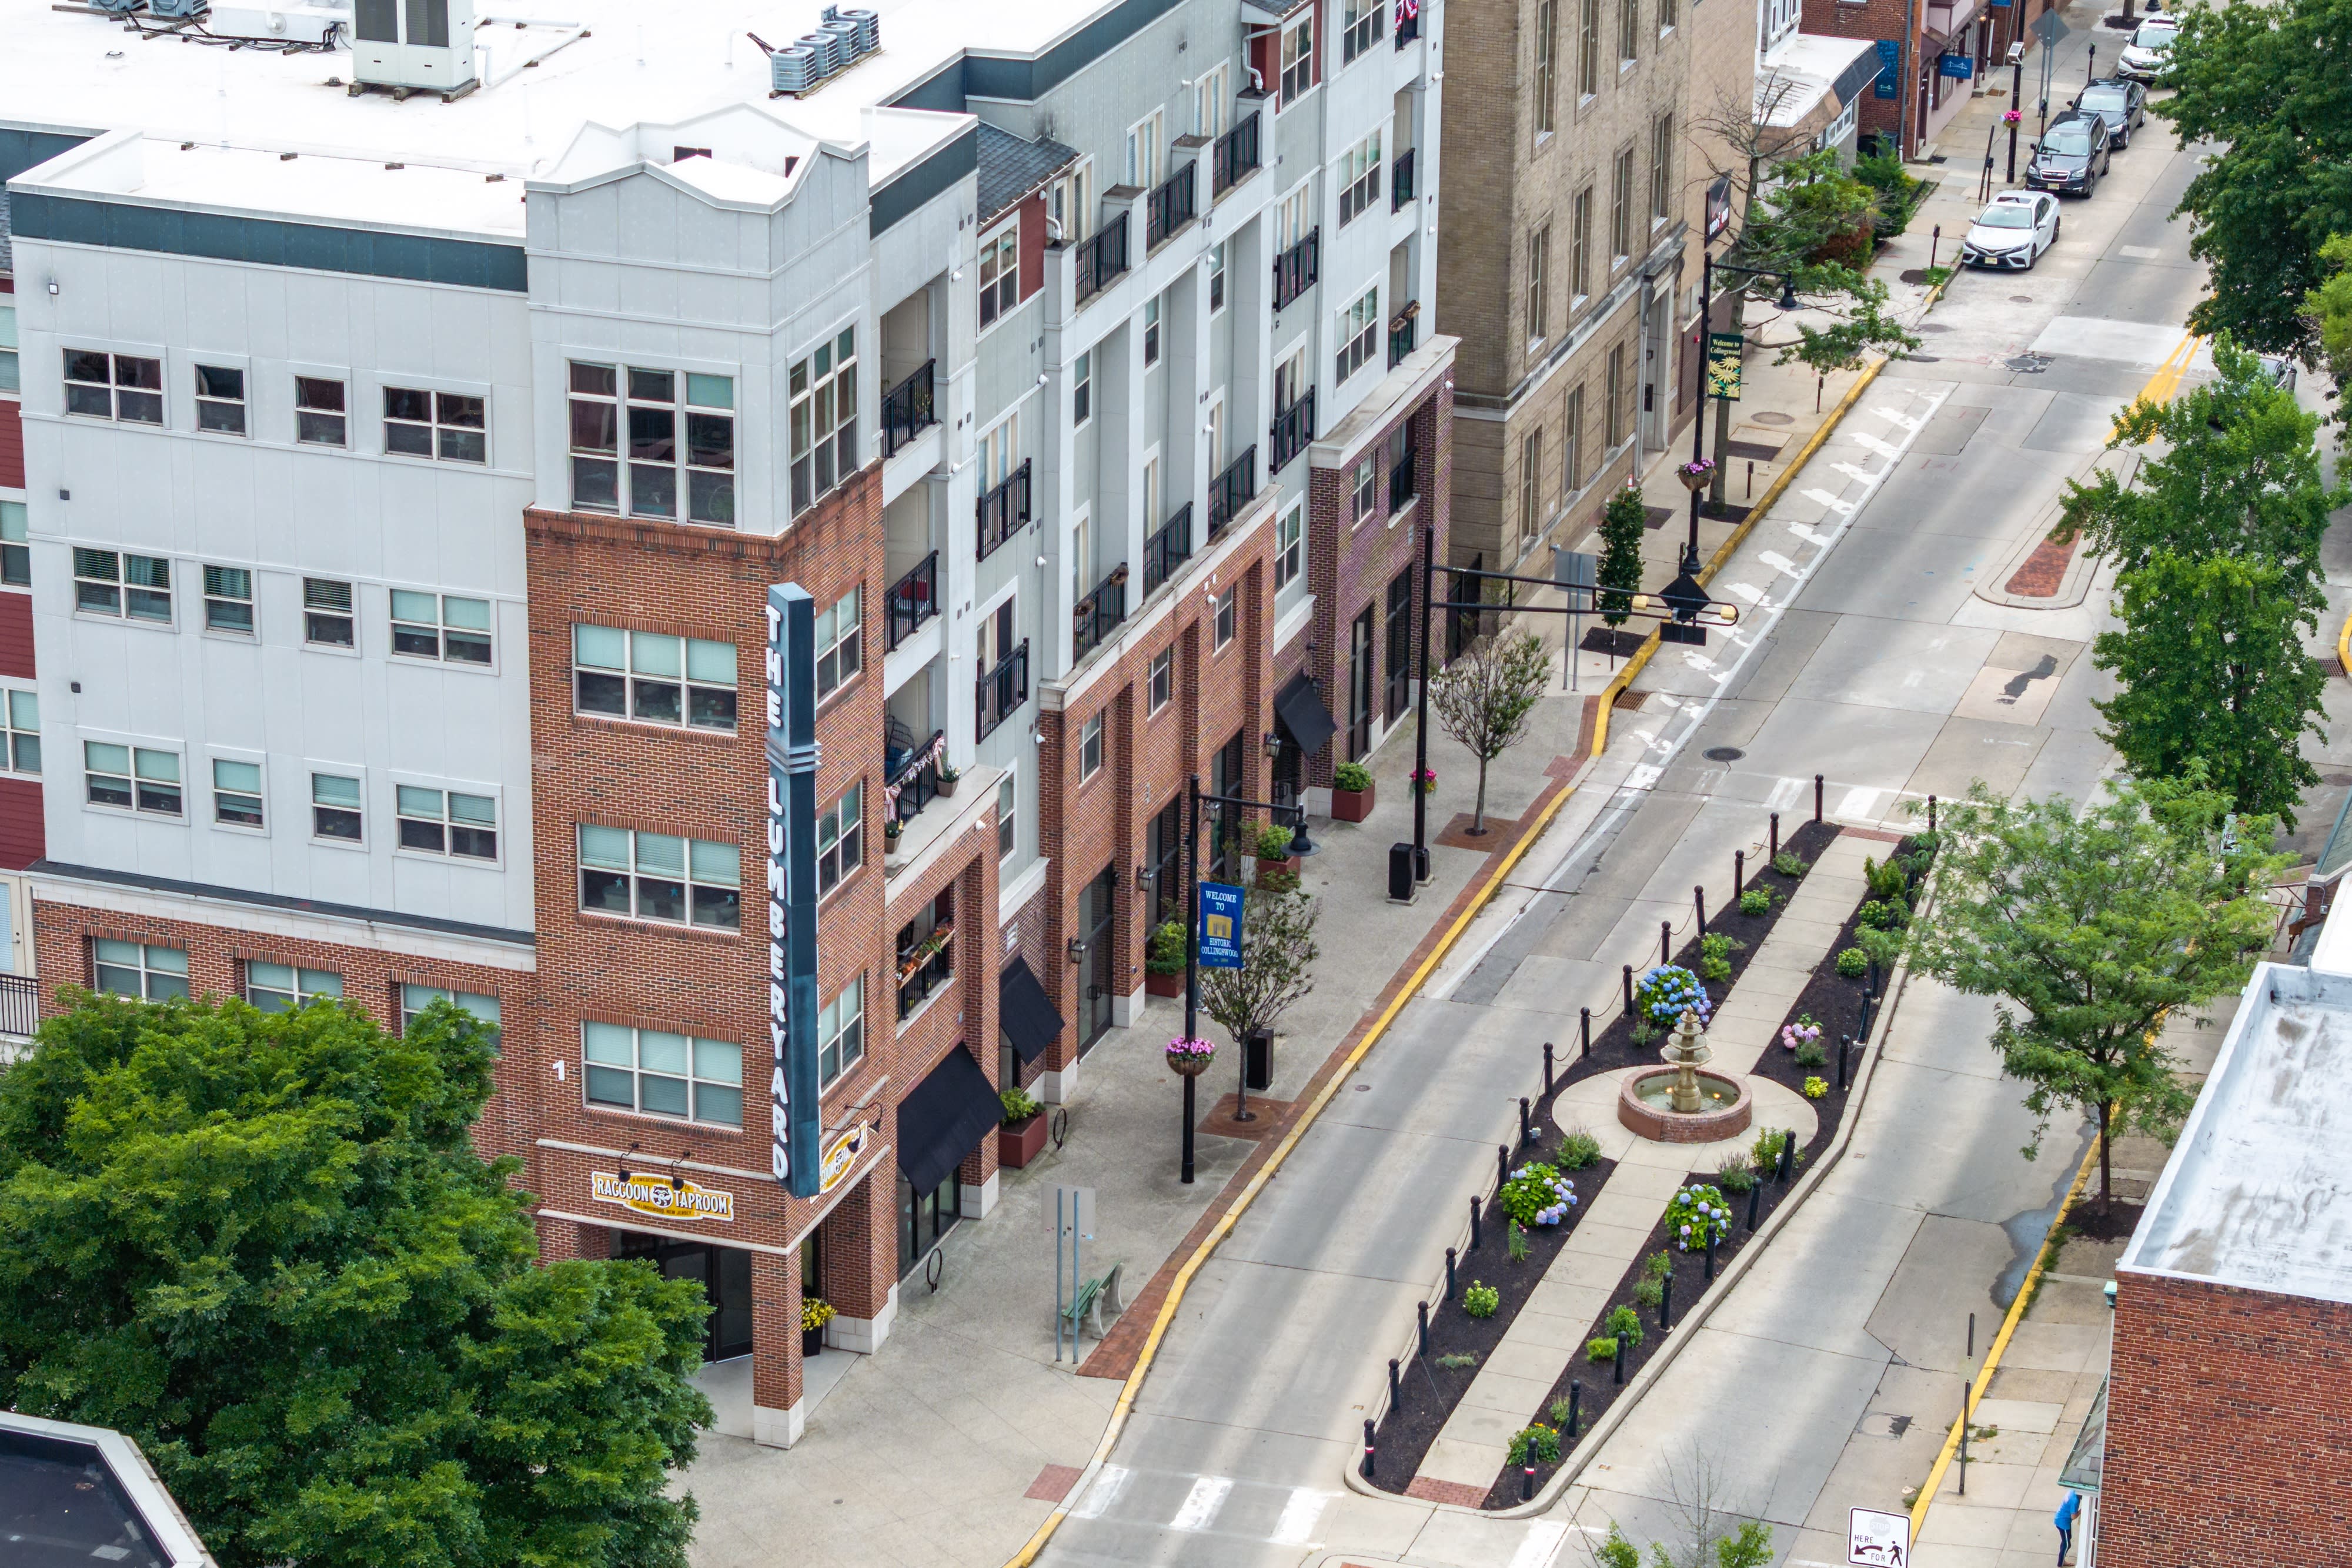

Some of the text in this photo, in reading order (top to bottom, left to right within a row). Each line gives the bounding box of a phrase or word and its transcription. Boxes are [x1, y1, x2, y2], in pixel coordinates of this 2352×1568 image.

[1710, 347, 1741, 356] Collingswood
[766, 604, 789, 1179] THE LUMBERYARD
[1205, 890, 1237, 903] WELCOME
[1215, 902, 1224, 911] TO
[1210, 937, 1232, 948] HISTORIC
[1201, 946, 1238, 958] COLLINGSWOOD
[553, 1060, 565, 1081] 1
[597, 1178, 728, 1214] RACCOON TAPROOM
[1855, 1534, 1874, 1543] HERE
[1871, 1553, 1886, 1562] FOR
